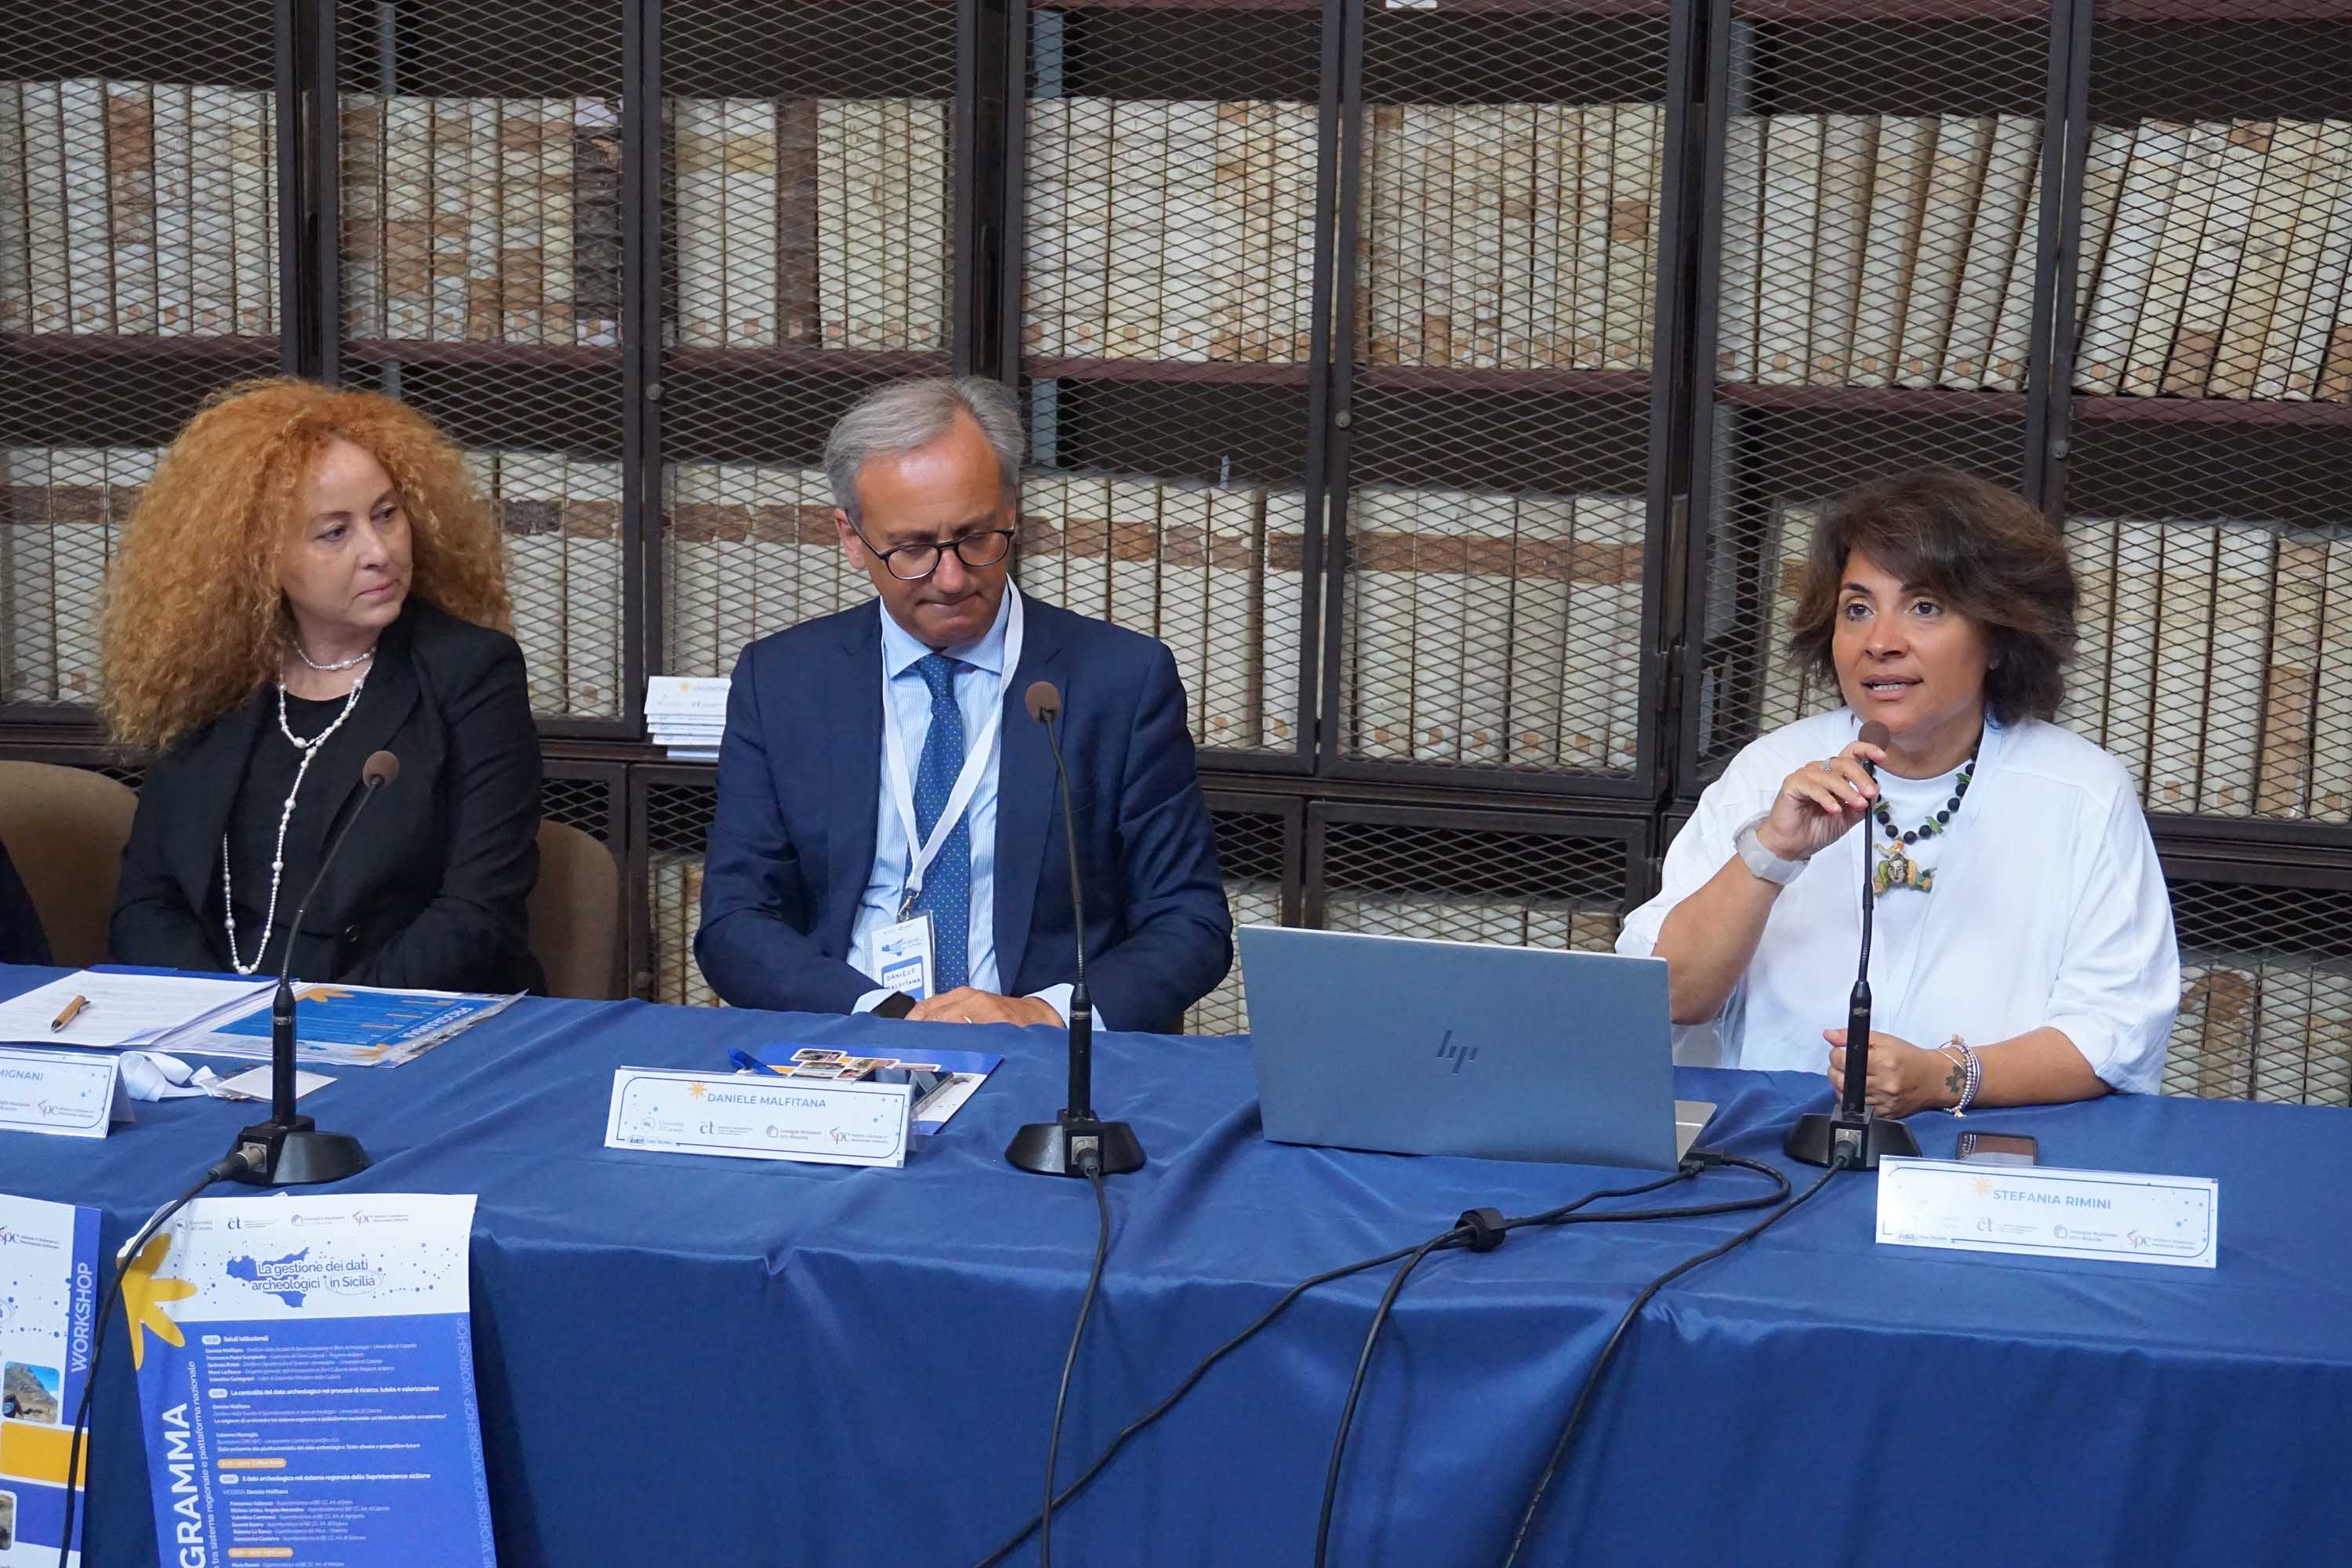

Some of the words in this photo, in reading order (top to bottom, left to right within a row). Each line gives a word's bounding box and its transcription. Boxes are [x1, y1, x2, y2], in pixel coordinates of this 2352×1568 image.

[1436, 1029, 1479, 1075] hp
[707, 1093, 757, 1105] DANIELE
[760, 1097, 826, 1109] MALFITANA
[1993, 1189, 2061, 1205] STEFANIA
[2066, 1196, 2111, 1210] RIMINI
[252, 1278, 321, 1292] archeologici
[330, 1276, 340, 1288] in
[342, 1274, 376, 1288] Sicilia
[258, 1263, 272, 1275] La
[273, 1262, 324, 1278] gestione
[325, 1260, 343, 1272] dei
[346, 1258, 368, 1272] dati
[71, 1261, 93, 1374] WORKSHOP
[457, 1316, 472, 1394] WORKSHOP
[188, 1360, 200, 1406] nazionale
[194, 1406, 209, 1461] piattaforma
[463, 1398, 483, 1475] WORKSHOP
[162, 1402, 207, 1568] GRAMMA
[201, 1460, 208, 1468] e
[201, 1468, 214, 1512] regionale
[207, 1514, 218, 1551] sistema
[474, 1476, 493, 1554] WORKSHOP
